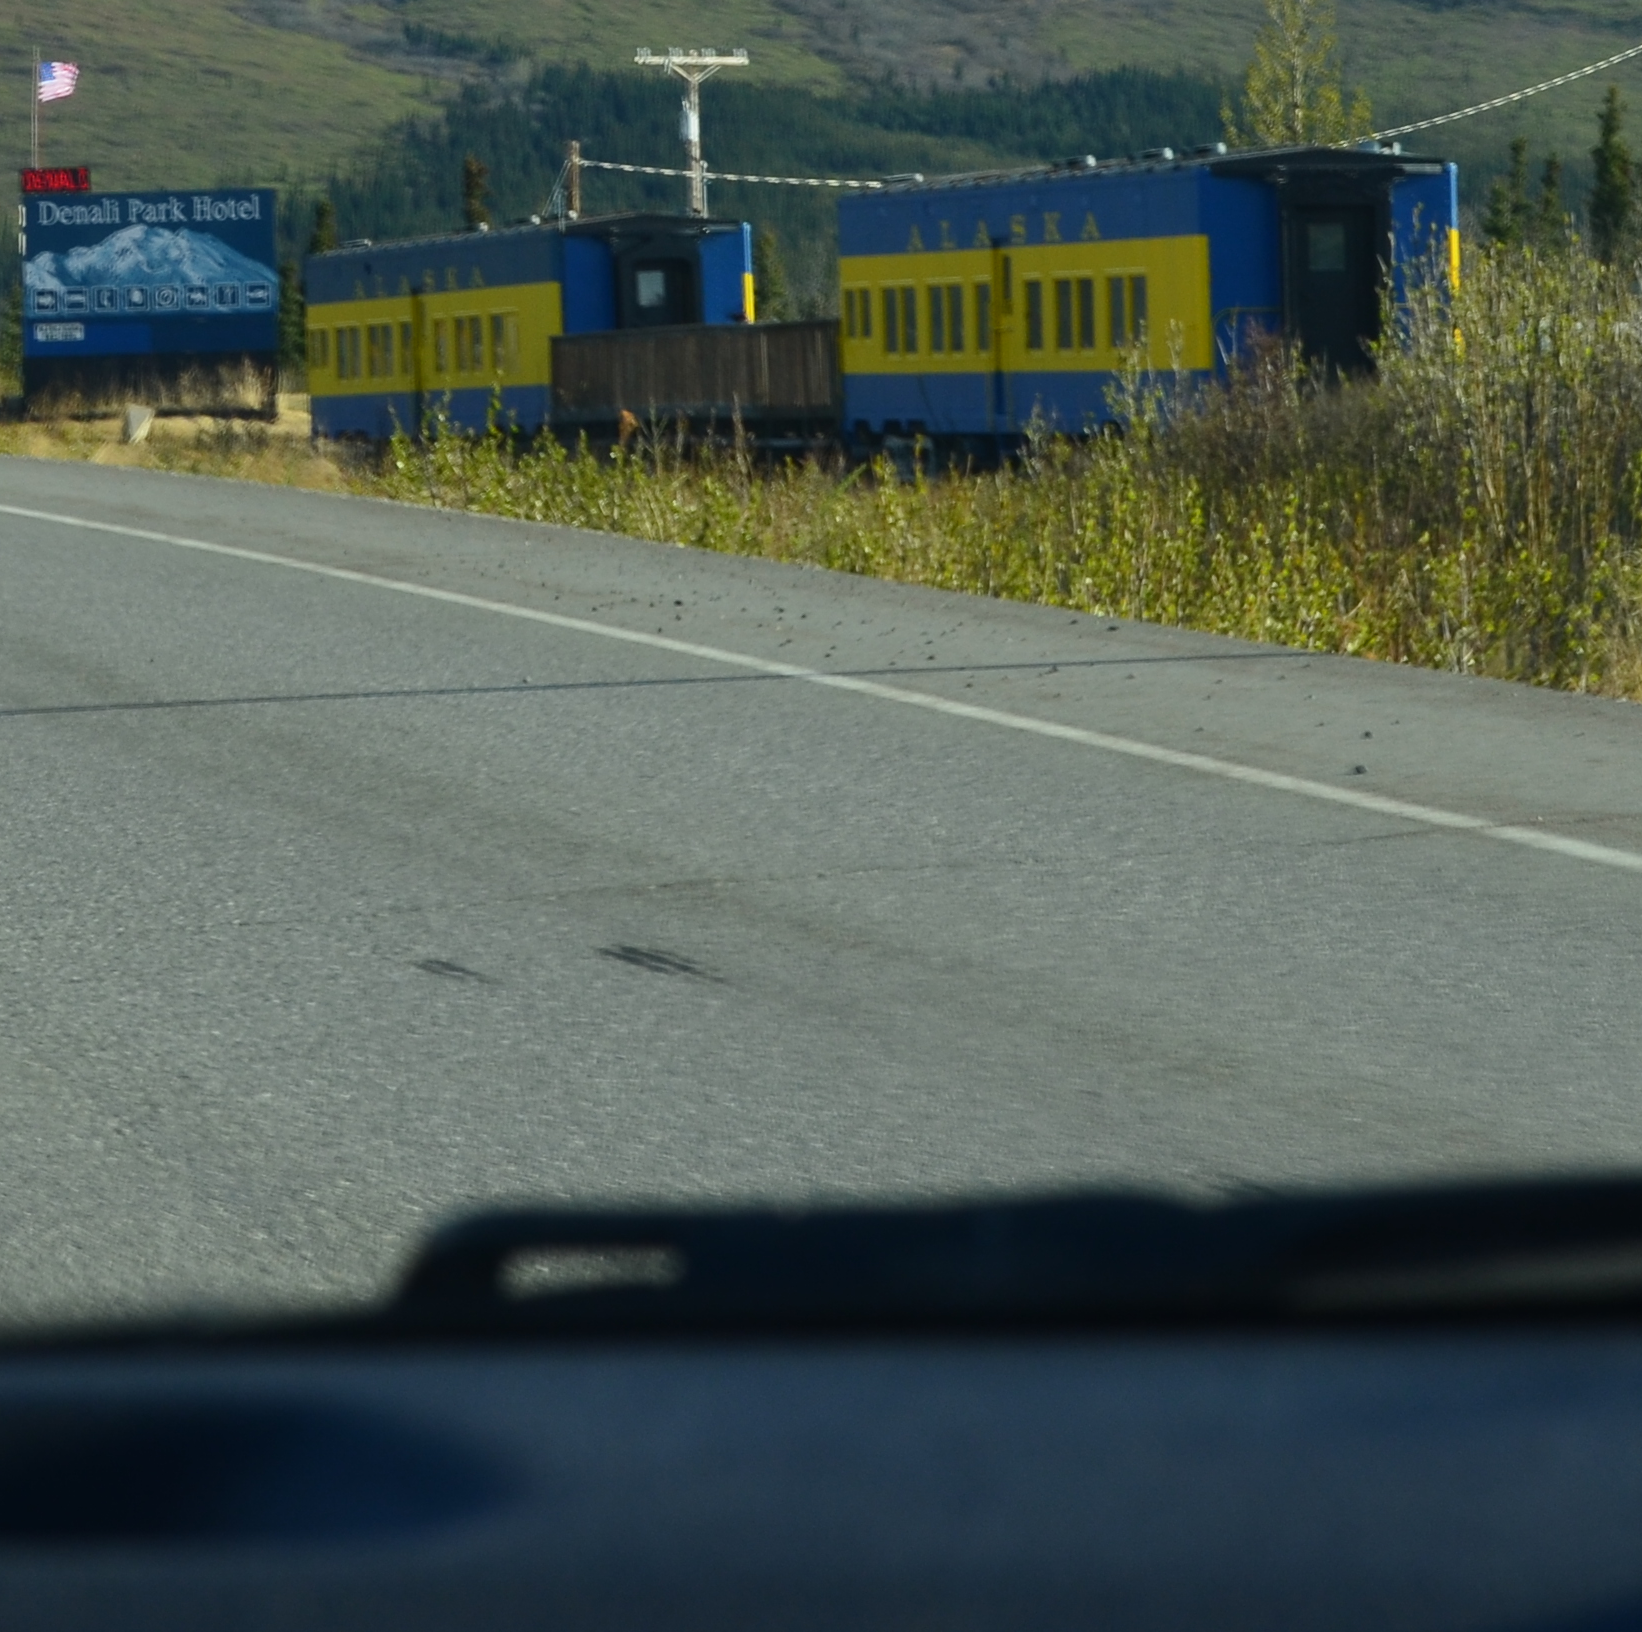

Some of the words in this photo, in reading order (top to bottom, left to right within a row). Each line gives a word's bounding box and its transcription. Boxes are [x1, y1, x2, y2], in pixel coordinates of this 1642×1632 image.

[38, 198, 120, 225] Denali
[127, 196, 187, 223] Park
[192, 194, 262, 220] Hotel
[908, 211, 1101, 253] ALASKA
[354, 265, 485, 299] ALASKA
